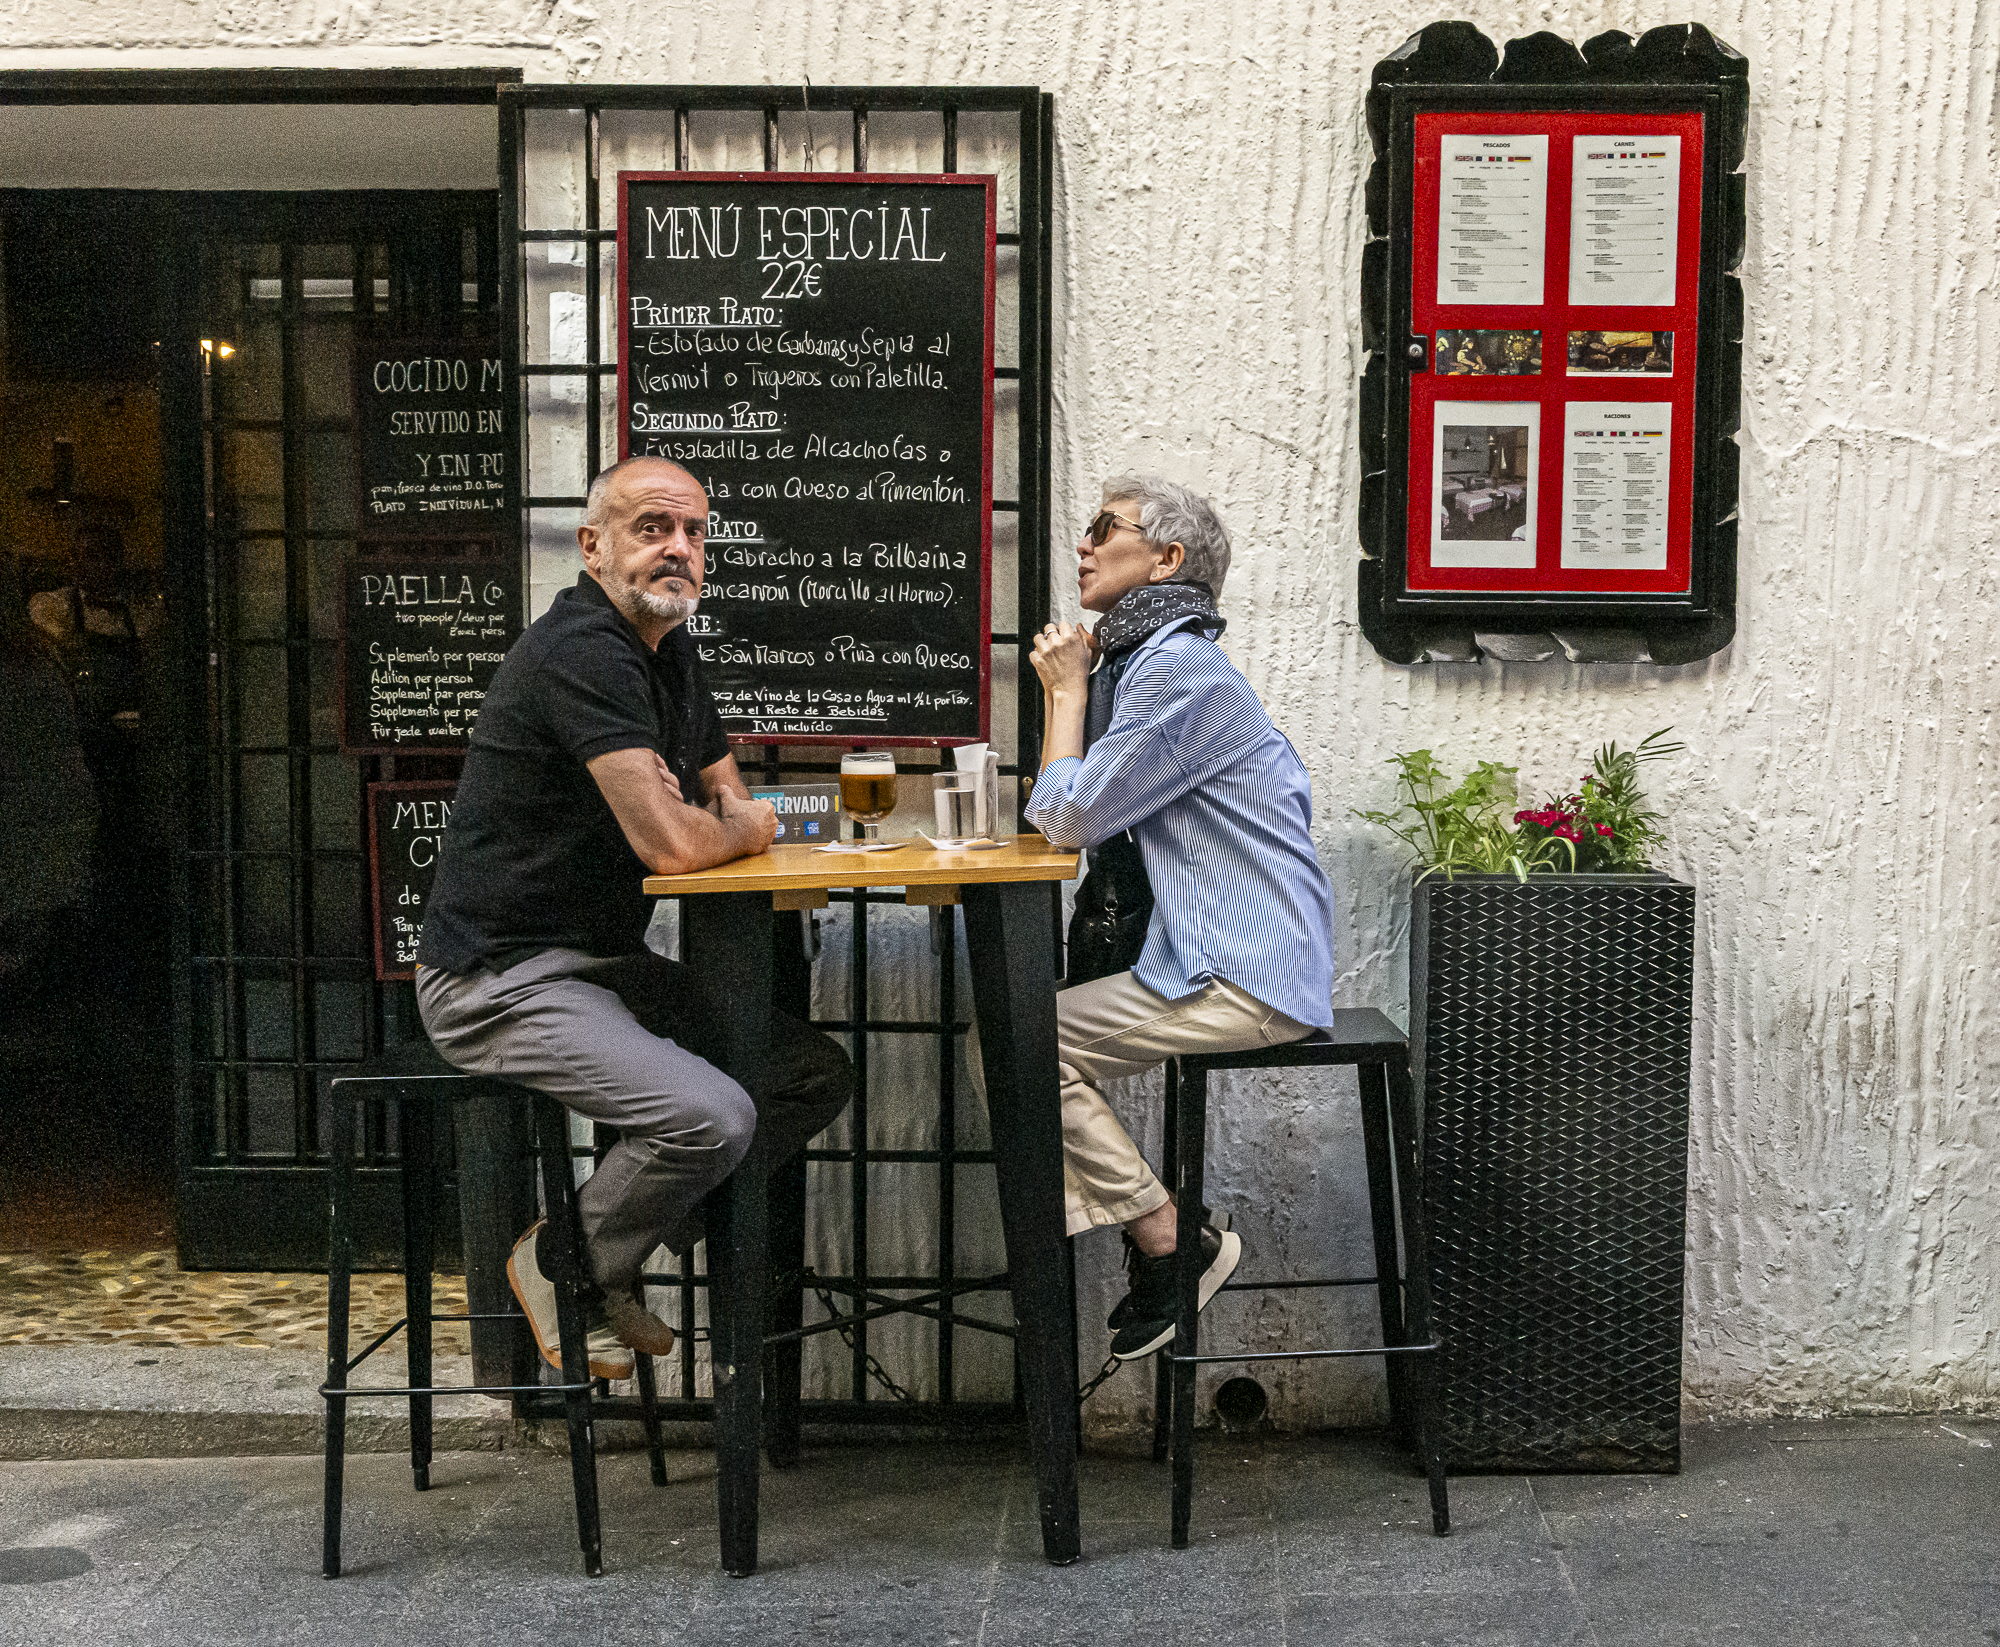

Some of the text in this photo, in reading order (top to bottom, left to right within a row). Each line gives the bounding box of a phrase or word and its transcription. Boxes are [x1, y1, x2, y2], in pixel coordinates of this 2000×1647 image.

[645, 200, 947, 262] MENÚ ESPECIAL
[761, 260, 823, 300] 22€
[630, 296, 783, 325] PRIMER PLATO:
[746, 331, 774, 353] de
[927, 332, 951, 356] al
[373, 356, 468, 393] COCIDO
[724, 372, 739, 387] o
[830, 373, 861, 388] con
[389, 409, 503, 435] SERVIDO EN
[631, 401, 788, 431] SEGUNDO PLATO:
[766, 439, 796, 460] de
[804, 433, 928, 461] Alcachofas
[939, 449, 952, 463] o
[415, 453, 432, 477] Y
[438, 453, 471, 477] EN
[429, 483, 442, 493] de
[742, 484, 778, 498] con
[783, 476, 850, 500] Queso
[856, 479, 876, 501] al
[370, 500, 406, 514] PLATO
[723, 546, 815, 567] Cabracho
[821, 552, 835, 568] a
[843, 546, 864, 567] la
[360, 574, 476, 606] PAELLA
[874, 585, 895, 603] al
[442, 652, 464, 670] por
[754, 643, 816, 666] Marcos
[825, 650, 835, 662] o
[881, 651, 912, 665] con
[916, 643, 974, 669] Queso.
[413, 675, 433, 690] per
[736, 689, 753, 701] de
[753, 686, 783, 702] Vino
[785, 690, 802, 703] de
[807, 689, 820, 703] la
[822, 689, 852, 703] Casa
[854, 695, 863, 703] o
[866, 689, 895, 708] Agua
[933, 697, 950, 711] por
[748, 706, 759, 715] el
[764, 704, 800, 716] Resto
[804, 706, 819, 716] de
[826, 704, 890, 717] Bebidas.
[443, 708, 461, 723] per
[752, 720, 779, 733] IVA
[393, 725, 422, 743] jede
[392, 916, 413, 933] Pan
